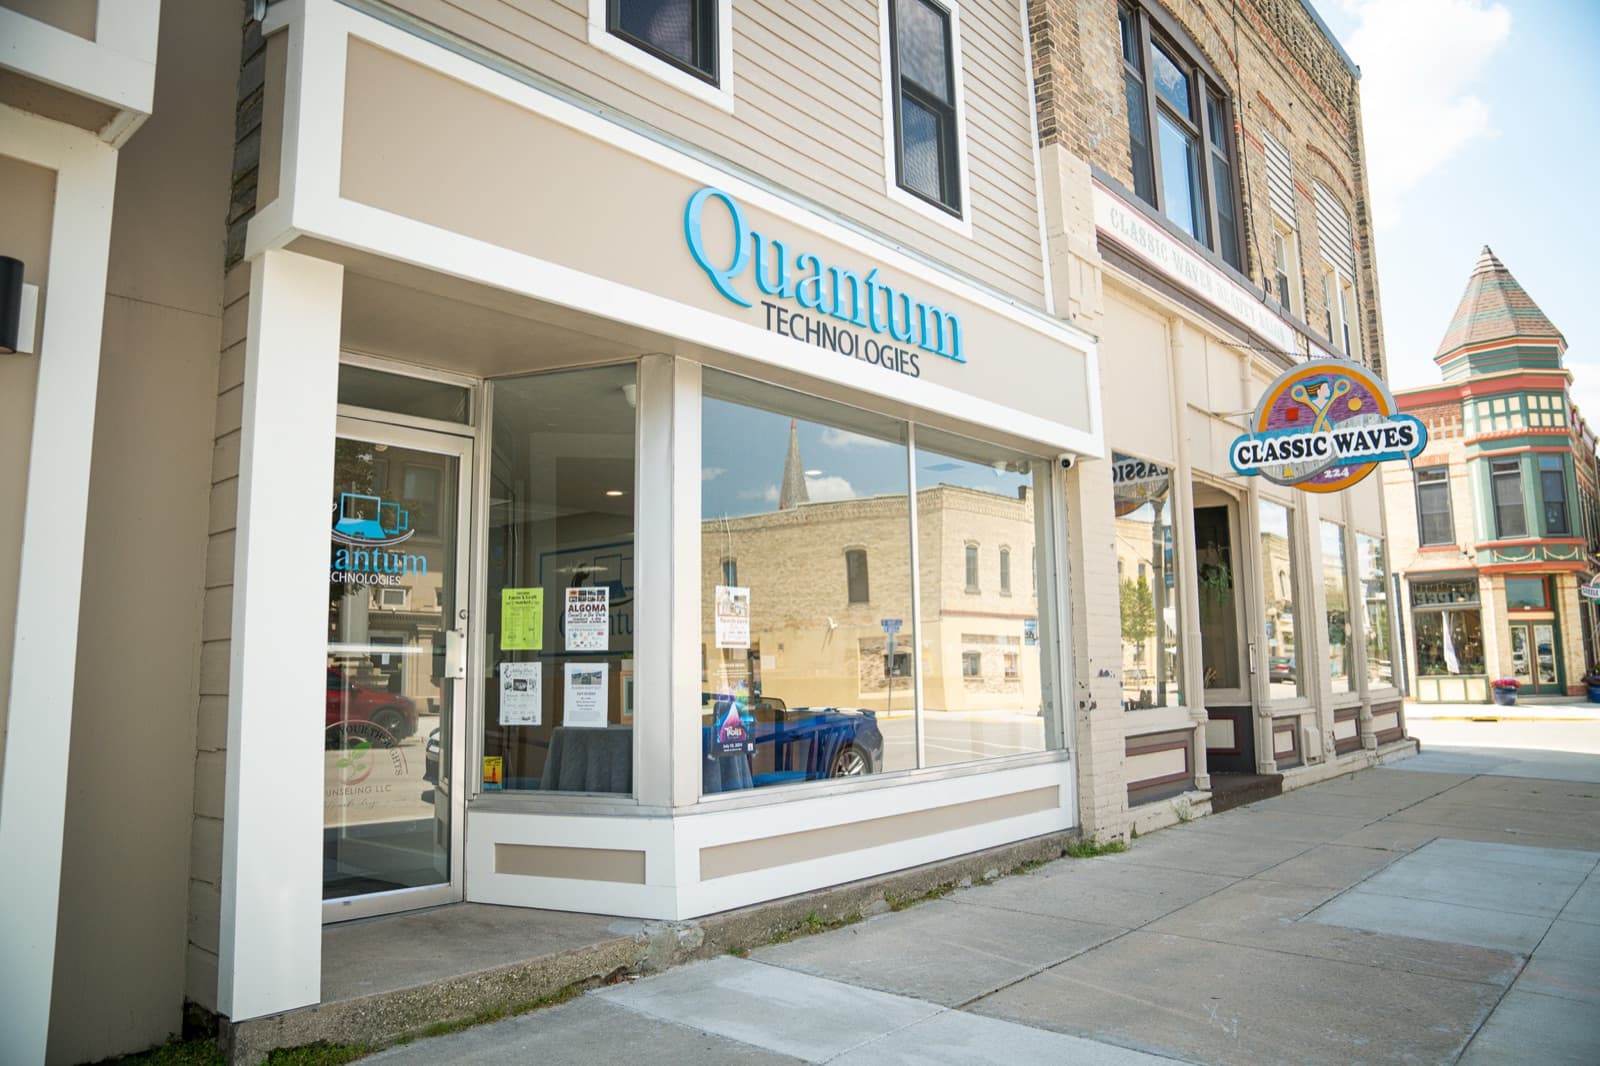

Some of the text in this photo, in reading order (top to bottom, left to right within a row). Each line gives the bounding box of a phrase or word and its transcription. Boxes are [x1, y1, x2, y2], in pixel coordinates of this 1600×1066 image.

[1110, 207, 1168, 265] CLASSIC
[684, 186, 967, 364] Quantum
[761, 301, 920, 378] TECHNOLOGIES
[1238, 425, 1413, 464] CLASSIC WAVES
[1324, 467, 1349, 478] 224
[334, 548, 427, 576] antum
[330, 571, 401, 585] CHNOLOGIES
[568, 604, 606, 613] ALGOMA
[326, 784, 393, 797] UNSELING LLC
